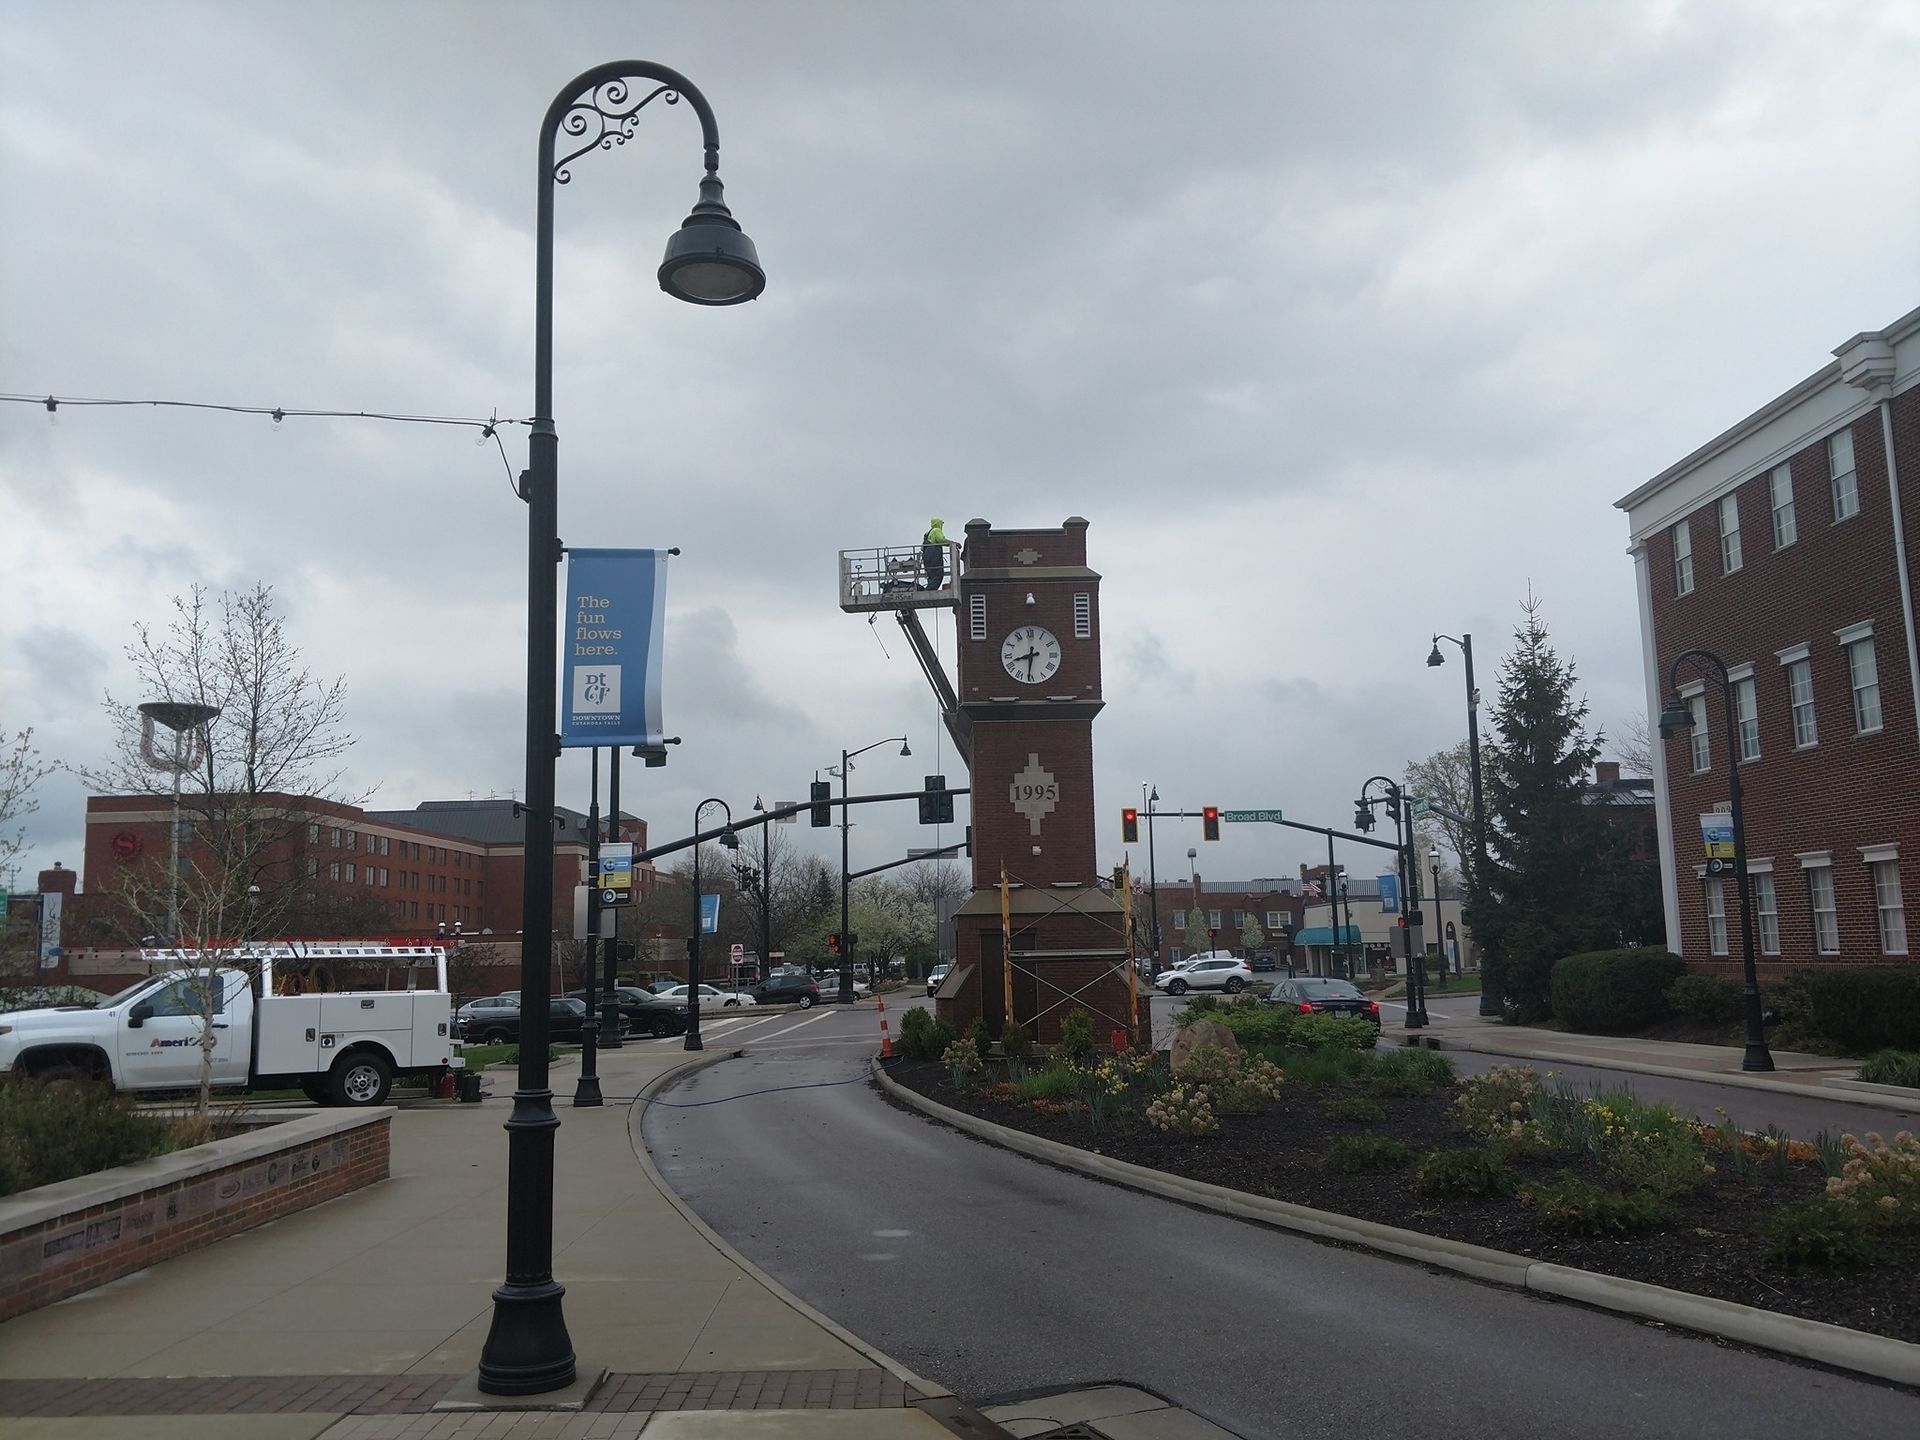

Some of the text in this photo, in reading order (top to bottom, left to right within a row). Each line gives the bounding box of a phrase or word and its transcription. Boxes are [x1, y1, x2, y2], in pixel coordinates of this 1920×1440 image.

[577, 595, 610, 608] The
[576, 611, 606, 624] fun
[576, 627, 622, 640] flows
[574, 643, 619, 656] here.
[1013, 784, 1056, 801] 1995
[1226, 811, 1281, 821] Broad Blvd
